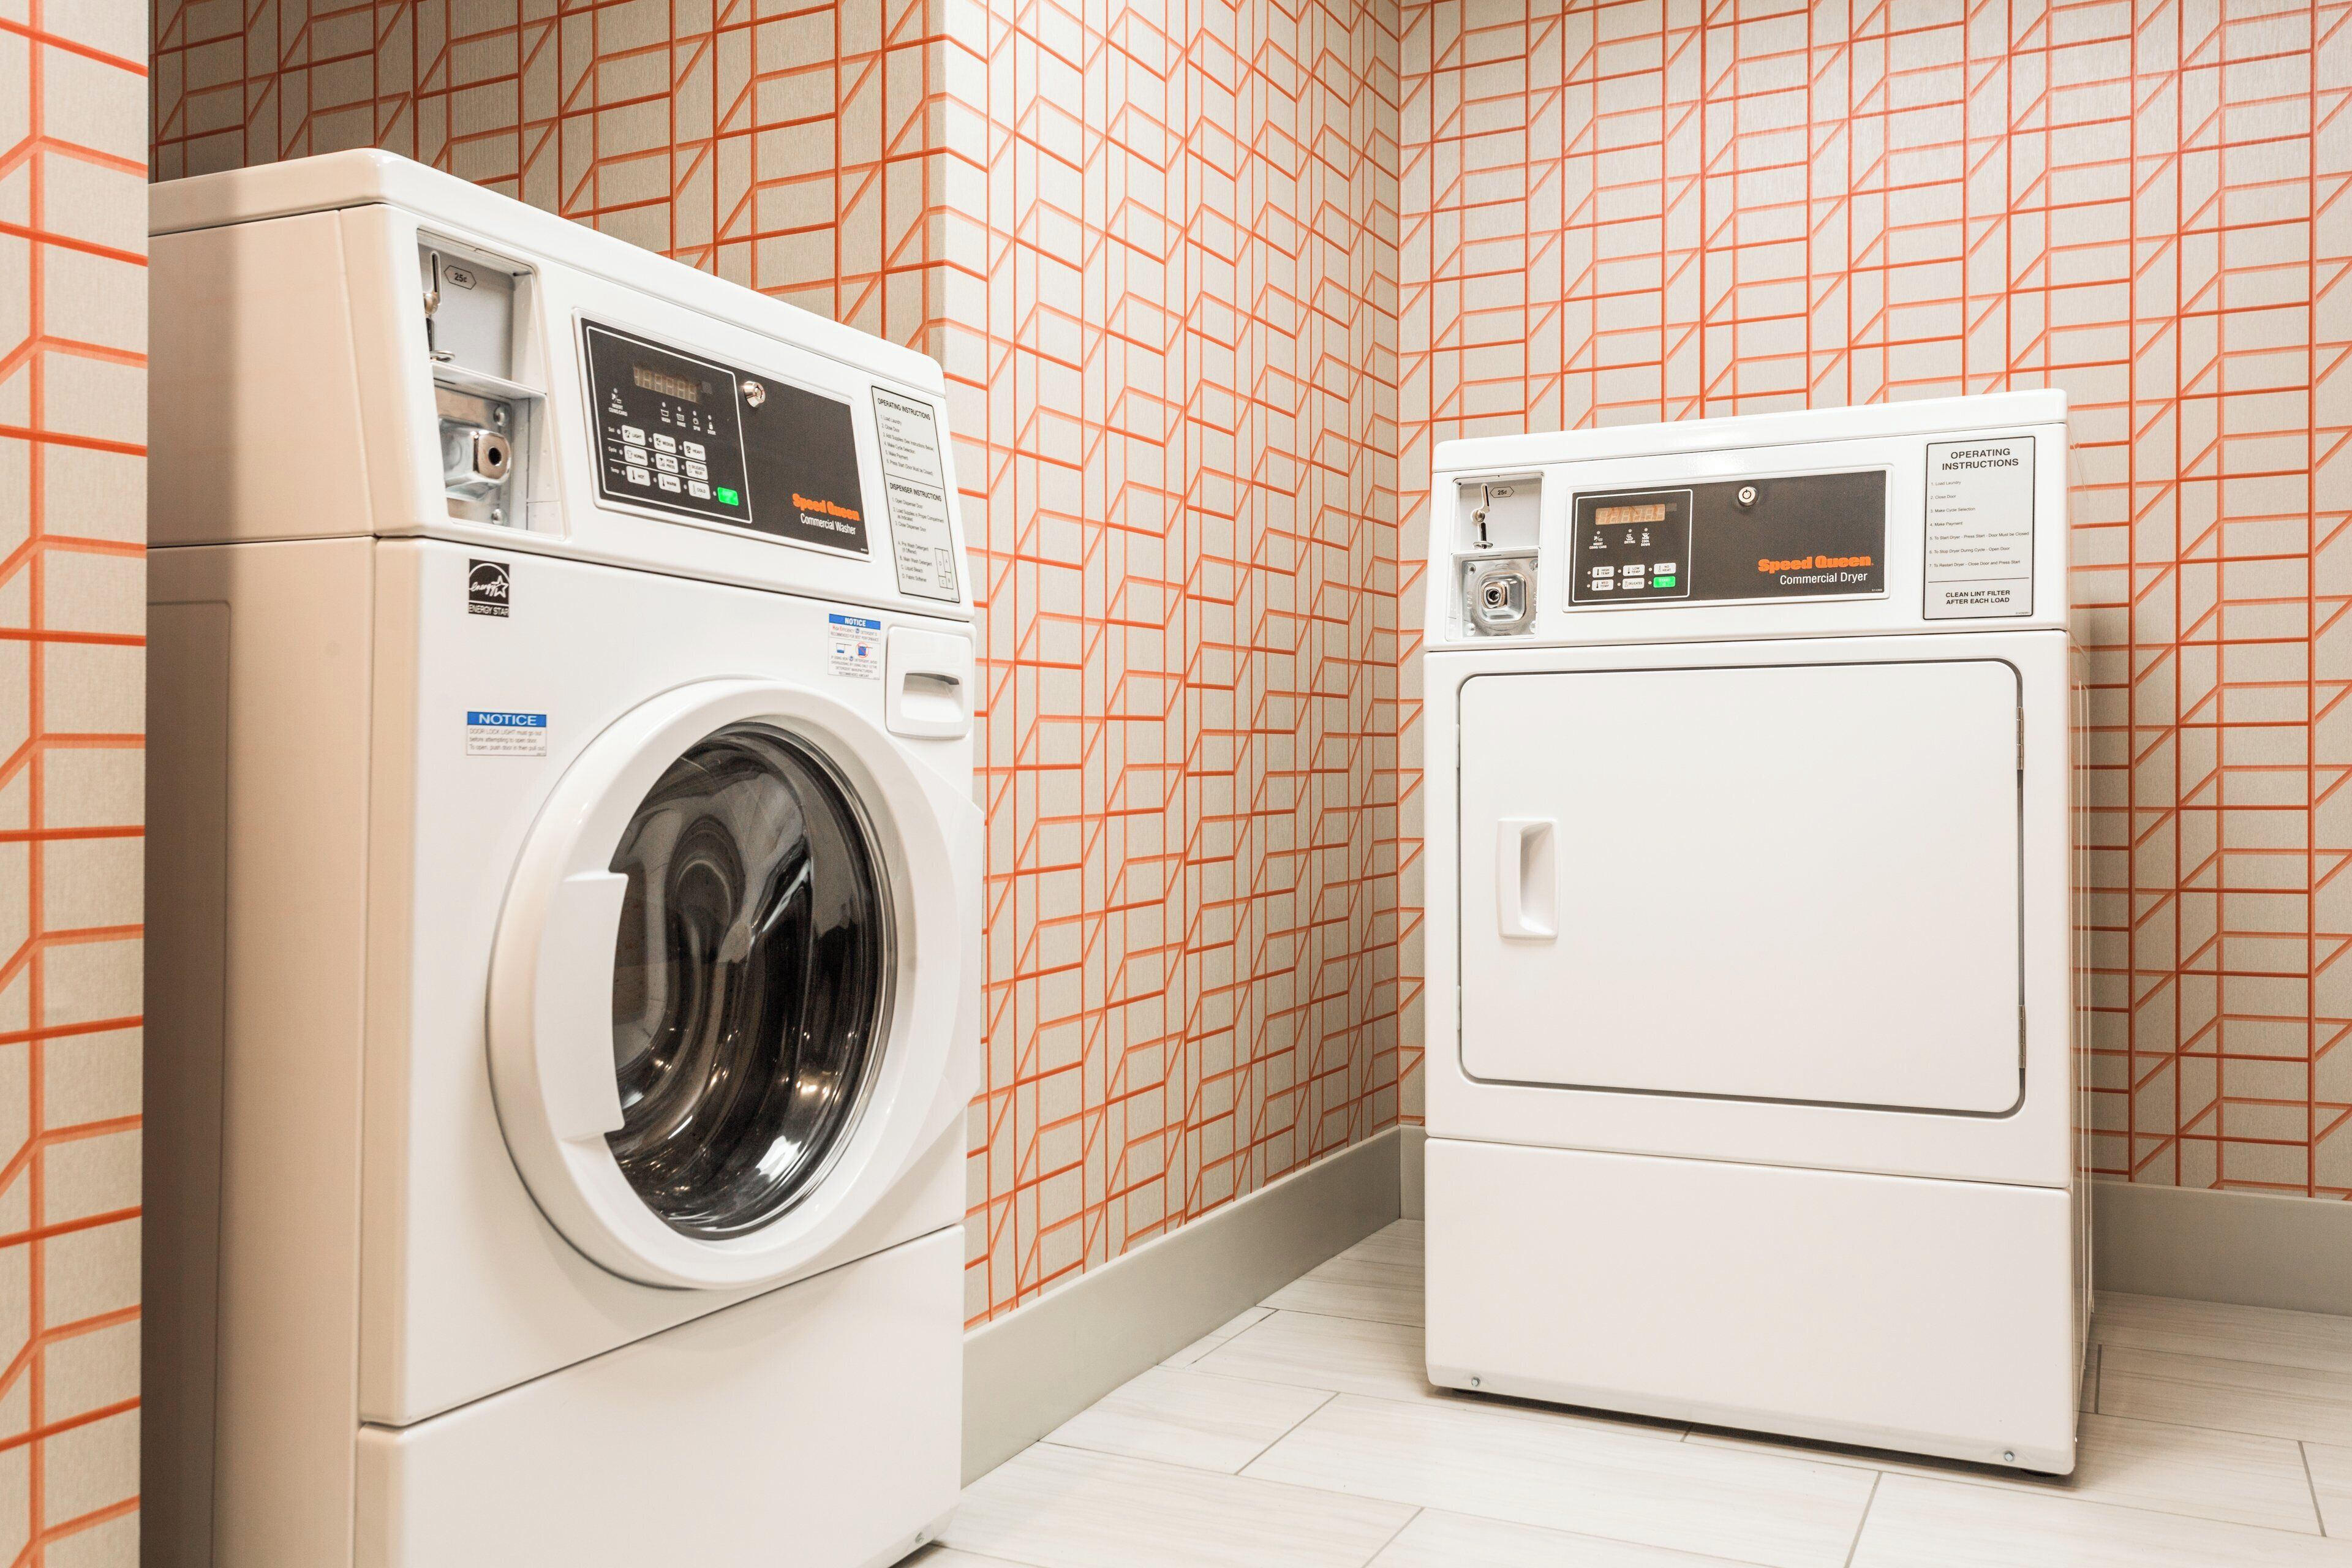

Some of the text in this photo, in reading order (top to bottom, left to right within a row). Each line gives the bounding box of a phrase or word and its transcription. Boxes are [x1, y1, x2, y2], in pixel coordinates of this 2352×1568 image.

[877, 398, 930, 420] OPERATING INSTRUCTIONS
[1951, 448, 2010, 459] OPERATING
[1942, 458, 2018, 470] INSTRUCTIONS
[889, 483, 941, 501] DISPENSER INSTRUCTIONS
[793, 493, 860, 521] Speed Queen
[801, 513, 856, 535] Commercial Washer
[1758, 555, 1871, 574] Speed Queen
[1780, 572, 1868, 585] Commercial Dryer
[469, 604, 509, 616] ENERGY STAR
[845, 617, 866, 627] NOTICE
[479, 714, 537, 726] NOTICE
